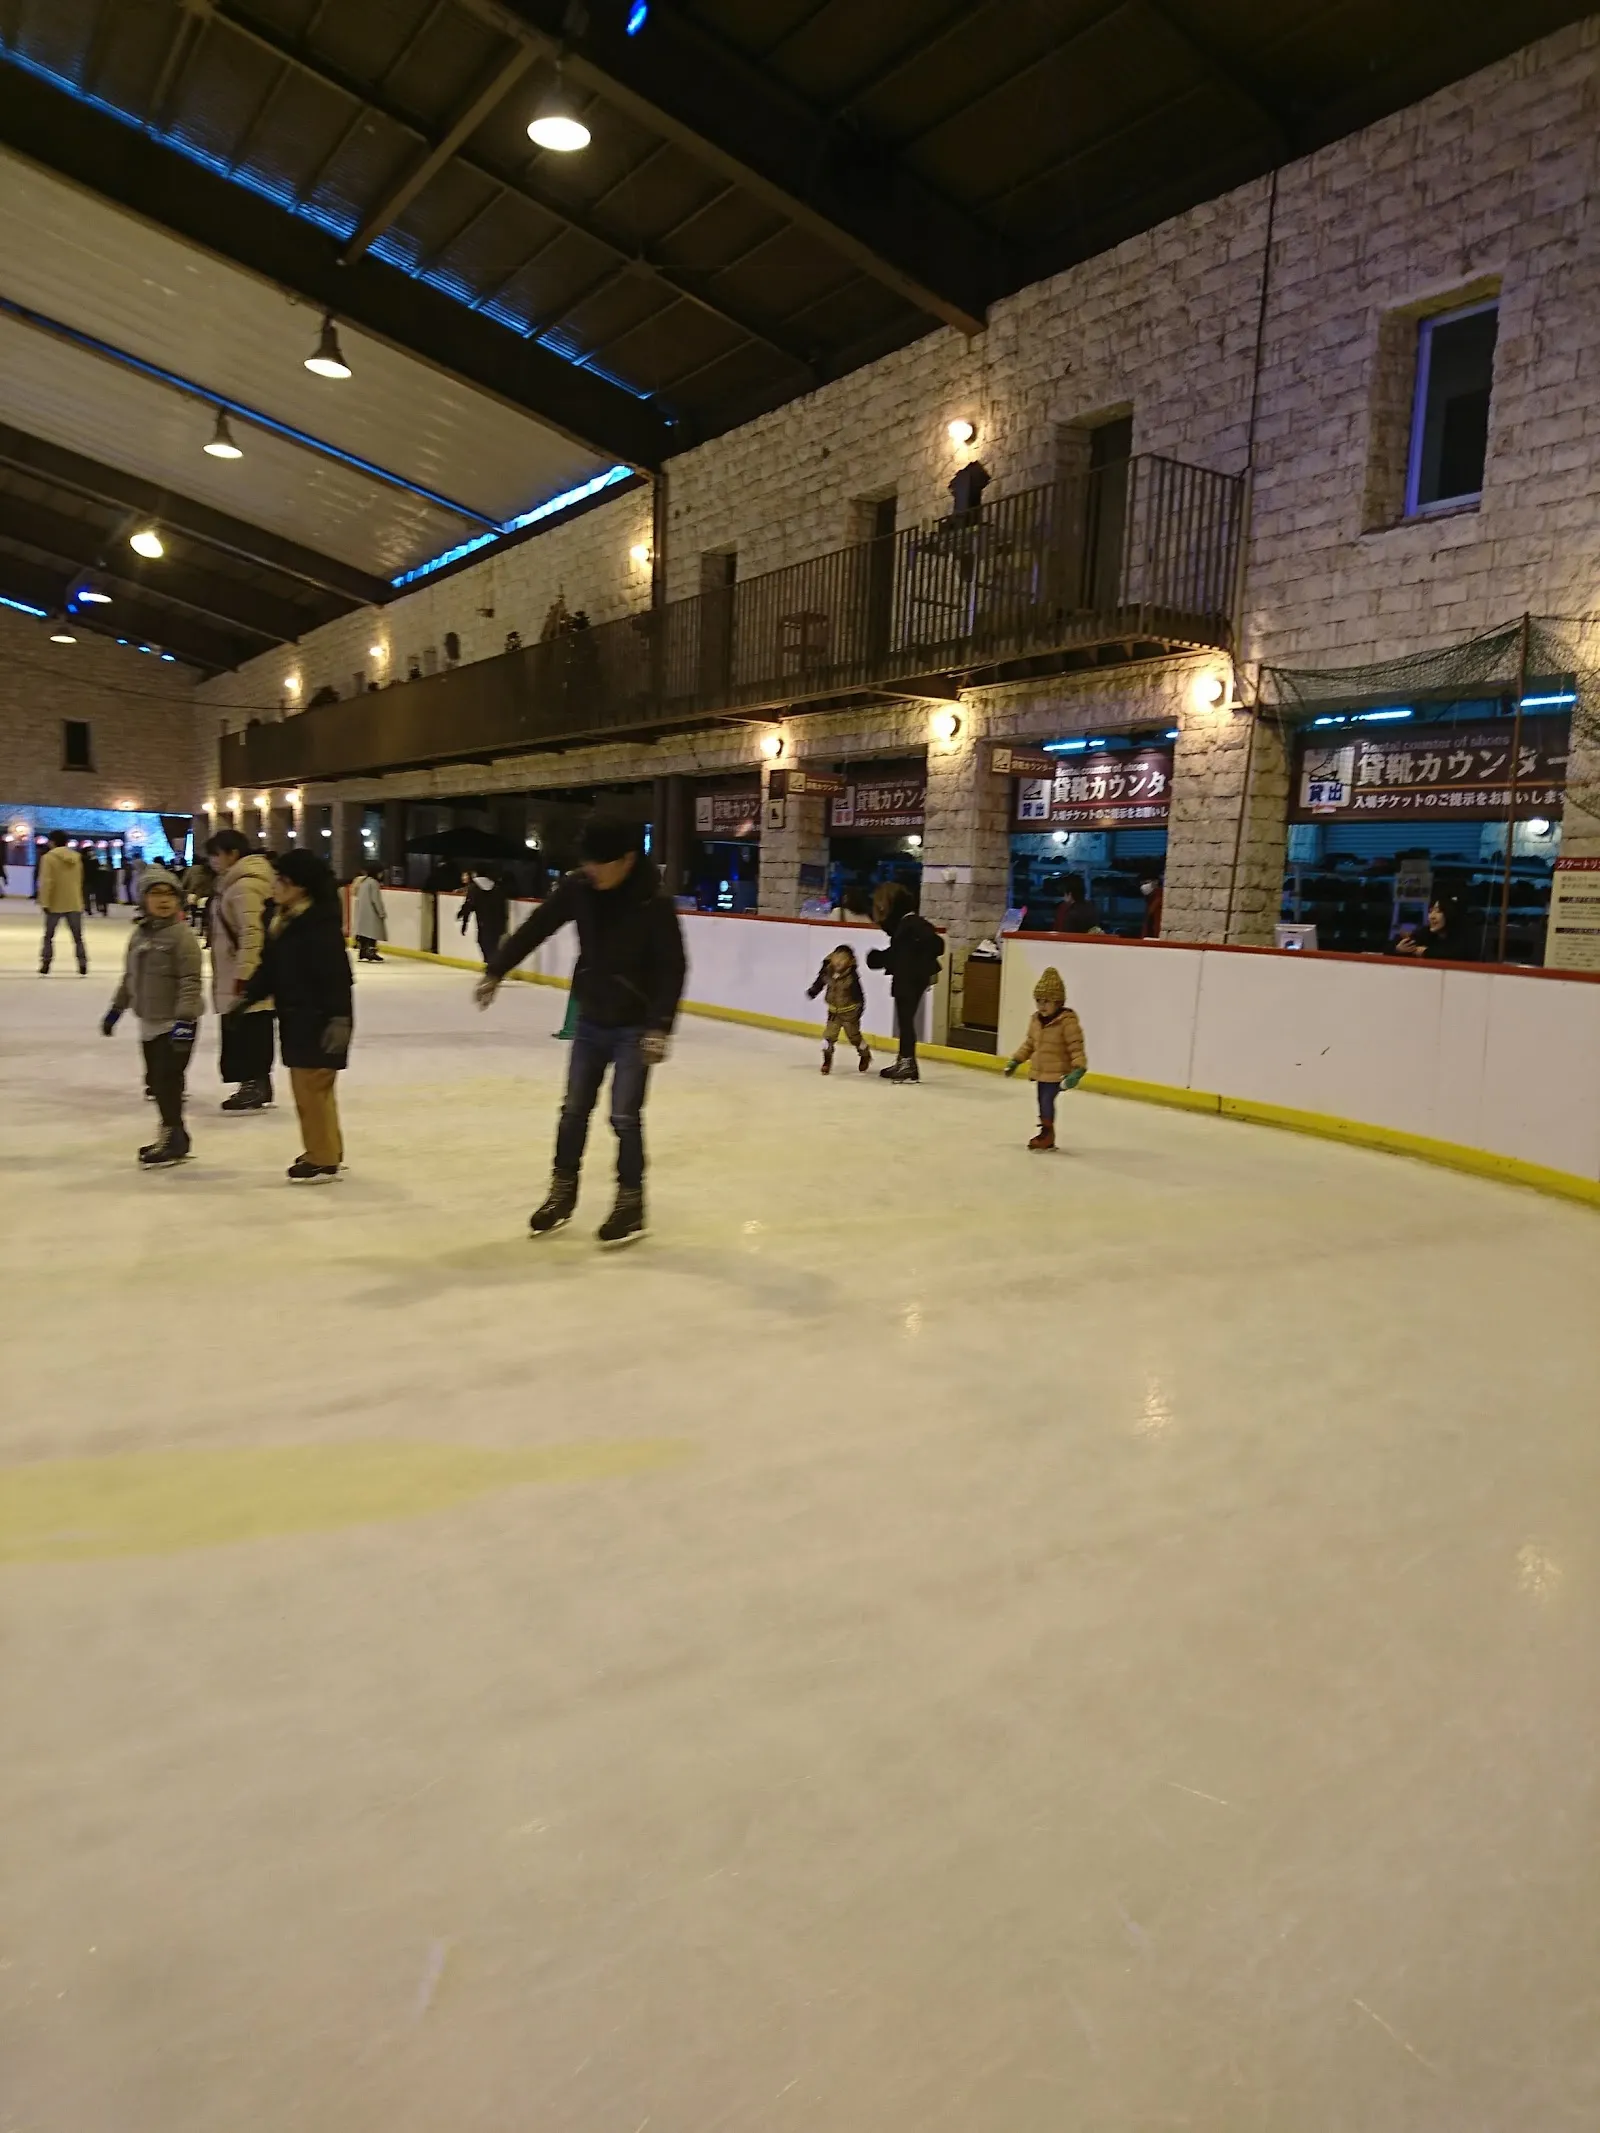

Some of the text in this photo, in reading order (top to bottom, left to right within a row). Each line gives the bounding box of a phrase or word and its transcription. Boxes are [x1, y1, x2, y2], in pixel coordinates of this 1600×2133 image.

[1052, 771, 1170, 803] 貸靴カウンタ
[1557, 859, 1600, 870] スケートリ
